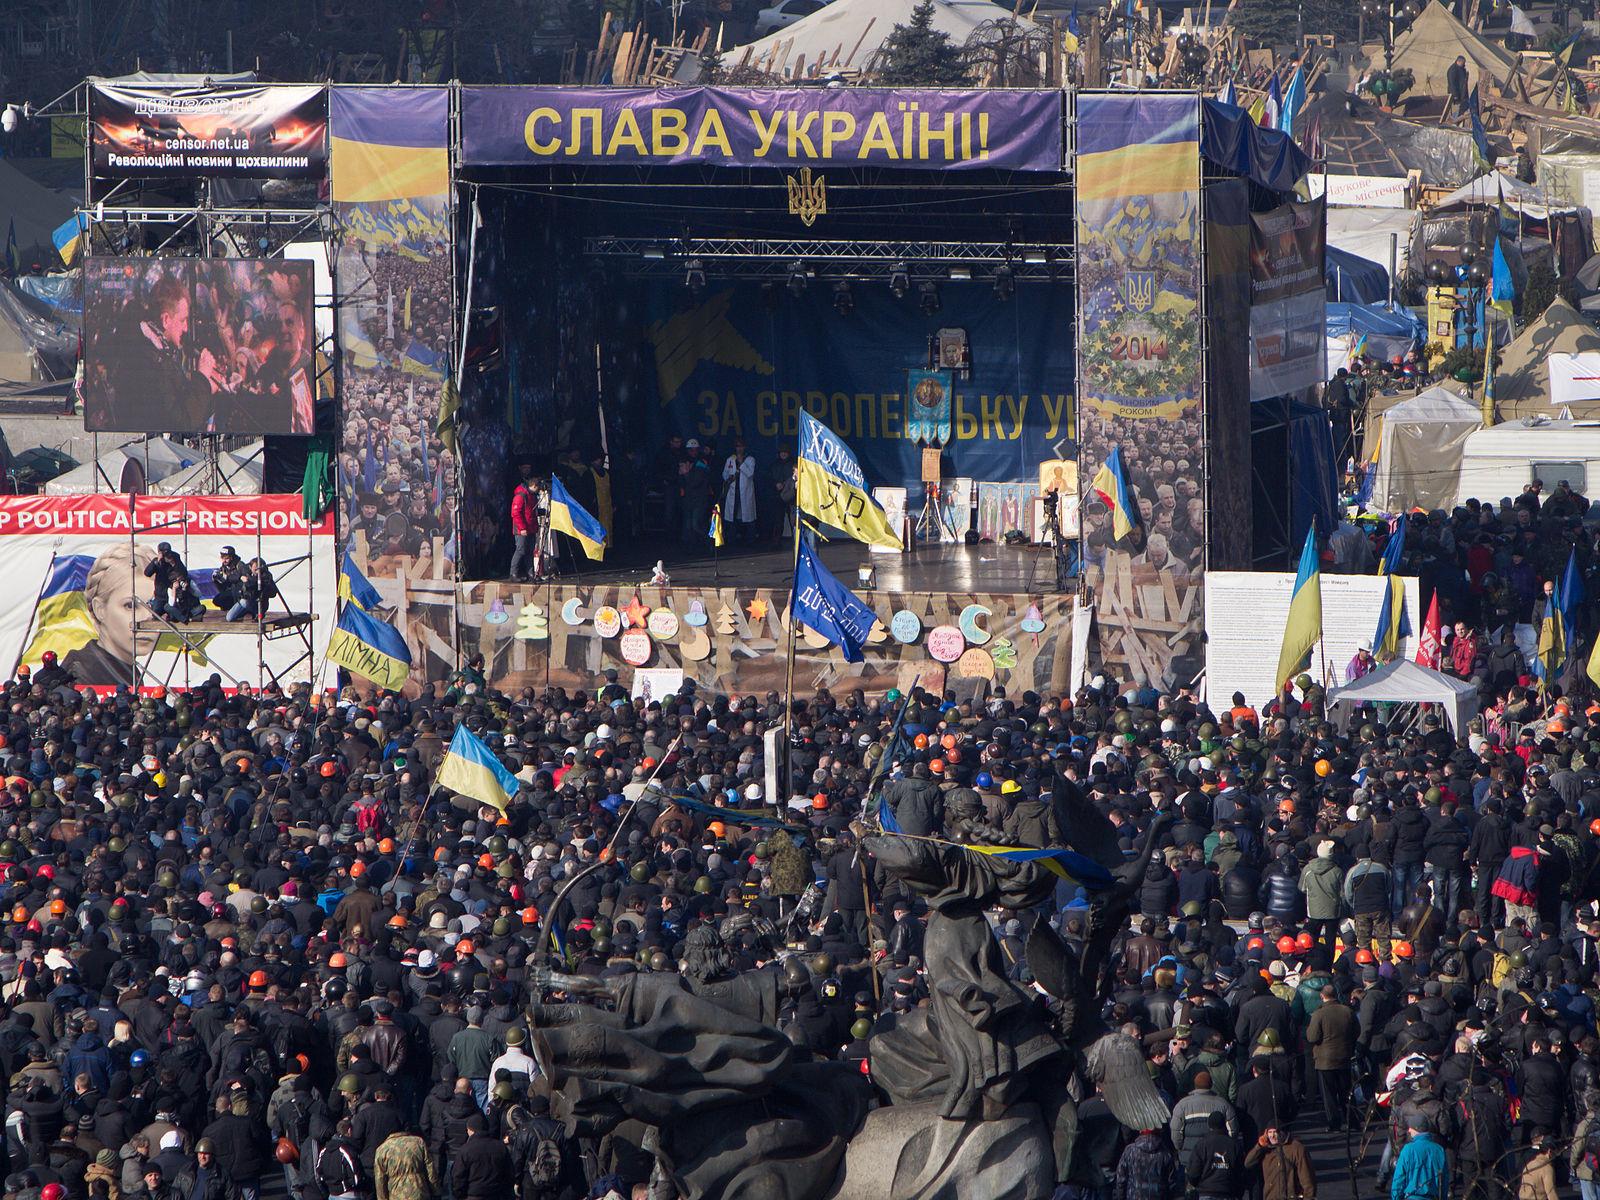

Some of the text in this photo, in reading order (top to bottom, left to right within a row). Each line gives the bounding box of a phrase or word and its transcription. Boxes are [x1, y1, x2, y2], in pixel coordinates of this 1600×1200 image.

[524, 101, 990, 160] СЛАВА УКРАЇНІ!
[165, 138, 250, 150] censor.net.ua
[108, 153, 309, 168] Революційні новини щохвилини
[1109, 331, 1169, 361] 2014
[1126, 399, 1160, 407] НОВИМ
[697, 390, 743, 436] ЗА
[757, 391, 1029, 441] ЄВРОПЕЬКУ
[18, 510, 146, 529] POLITICAL
